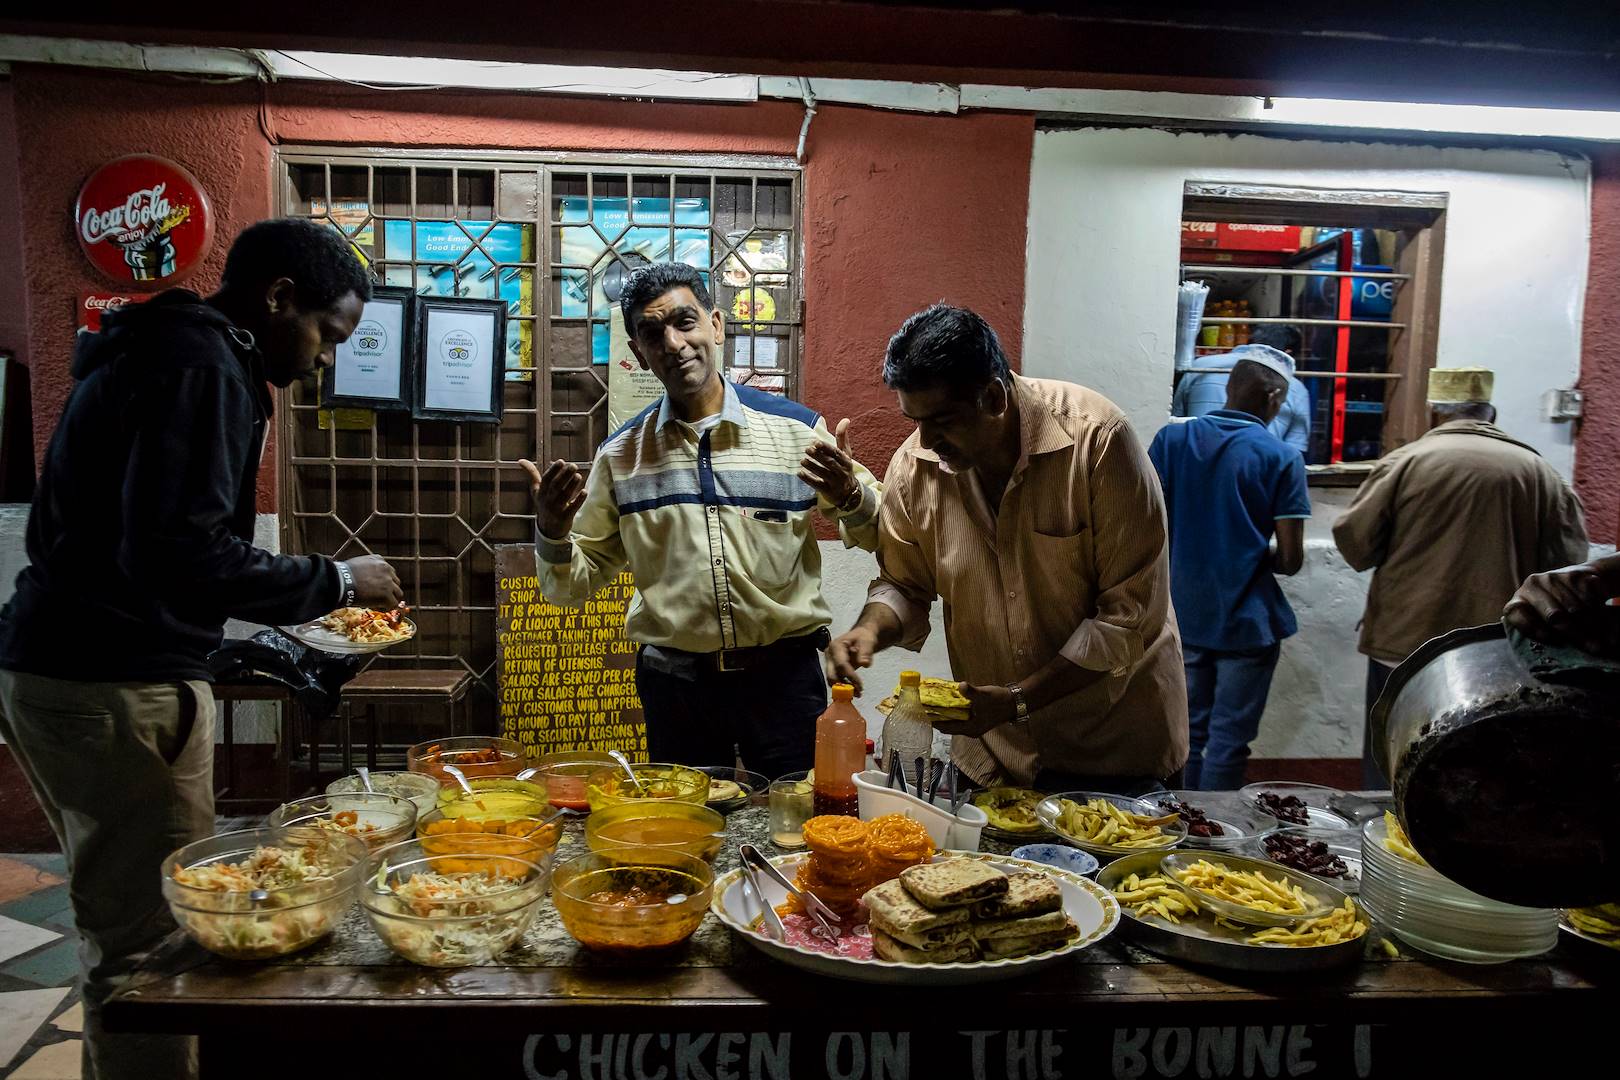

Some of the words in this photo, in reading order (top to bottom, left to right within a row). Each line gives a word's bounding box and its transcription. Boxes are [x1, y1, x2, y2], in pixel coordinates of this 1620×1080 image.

[82, 182, 170, 243] Coca-Cola
[603, 221, 625, 229] Good
[117, 228, 145, 242] enjoy
[427, 234, 445, 242] Low
[426, 243, 448, 251] Good
[1361, 281, 1393, 304] pe
[85, 295, 132, 310] Coca-C
[510, 590, 535, 603] SHOP
[595, 586, 619, 599] SOFT
[500, 604, 510, 618] IT
[513, 604, 524, 617] IS
[585, 600, 596, 614] TO
[597, 600, 625, 614] BRING
[511, 618, 523, 631] OF
[526, 616, 561, 630] LIQUOR
[565, 615, 577, 629] AT
[580, 614, 601, 628] THIS
[556, 629, 590, 642] TAKING
[592, 628, 615, 643] FOOD
[504, 643, 558, 659] REQUESTED
[573, 642, 607, 656] PLEASE
[504, 659, 541, 674] RETURN
[544, 658, 557, 672] OF
[559, 656, 606, 671] UTENSILS.
[501, 673, 540, 689] SALADS
[541, 672, 560, 686] ARE
[562, 670, 600, 685] SERVED
[602, 669, 621, 683] PER
[503, 687, 534, 702] EXTRA
[536, 686, 575, 701] SALADS
[576, 684, 594, 698] ARE
[597, 683, 637, 697] CHARGED
[501, 702, 520, 717] ANY
[524, 699, 575, 715] CUSTOMER
[577, 698, 599, 712] WHO
[600, 696, 643, 711] HAPPENS
[504, 717, 516, 731] IS
[518, 715, 550, 730] BOUND
[554, 714, 566, 728] TO
[568, 713, 587, 727] PAY
[590, 712, 606, 725] FOR
[519, 731, 536, 744] FOR
[538, 727, 587, 743] SECURITY
[588, 724, 634, 741] REASONS
[526, 743, 547, 759] OUT
[591, 737, 638, 753] VEHICLES
[521, 1032, 792, 1080] CHICKEN
[825, 1031, 911, 1080] ON
[955, 1027, 1069, 1080] THE
